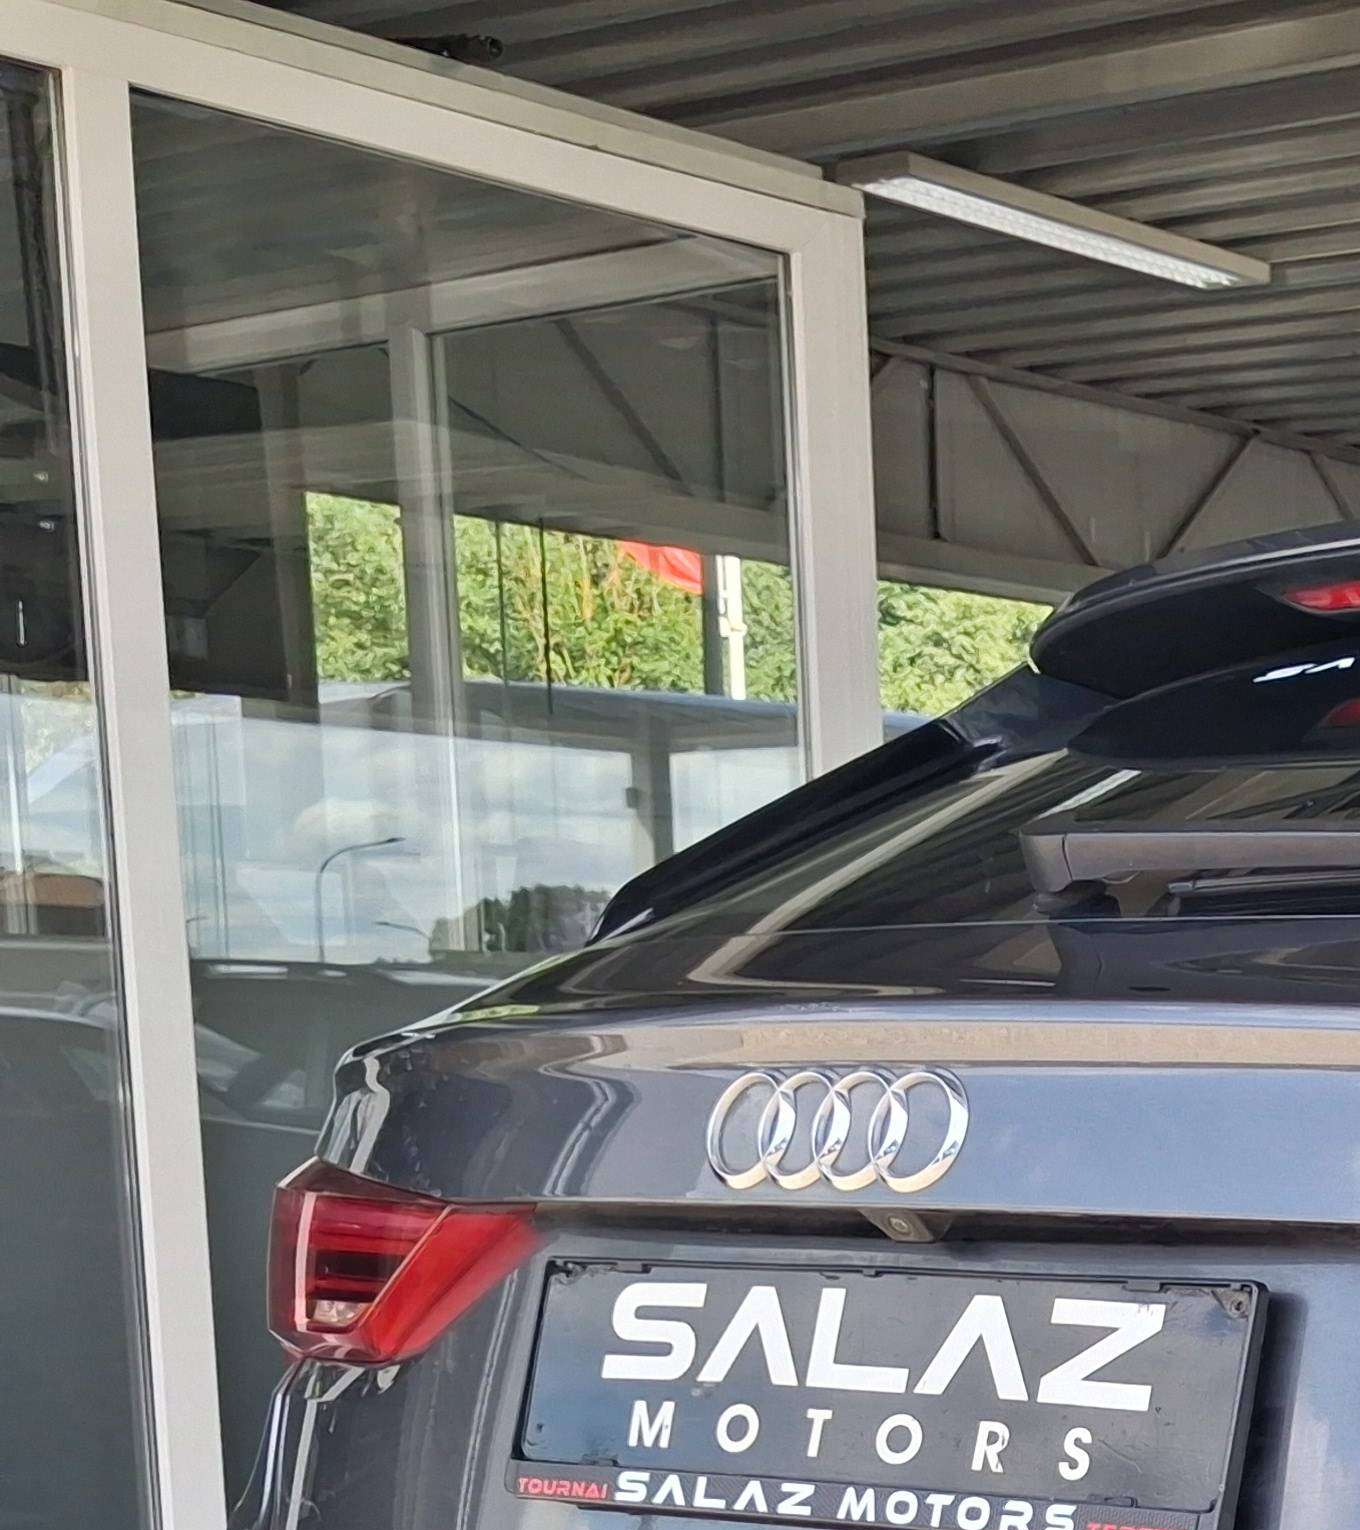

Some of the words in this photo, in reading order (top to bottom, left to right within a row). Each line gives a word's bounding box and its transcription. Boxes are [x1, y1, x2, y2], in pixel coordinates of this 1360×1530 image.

[600, 1281, 1168, 1413] SALAZ
[628, 1400, 1093, 1481] MOTORS
[518, 1477, 608, 1499] TOURNAI
[614, 1470, 817, 1517] SALAZ
